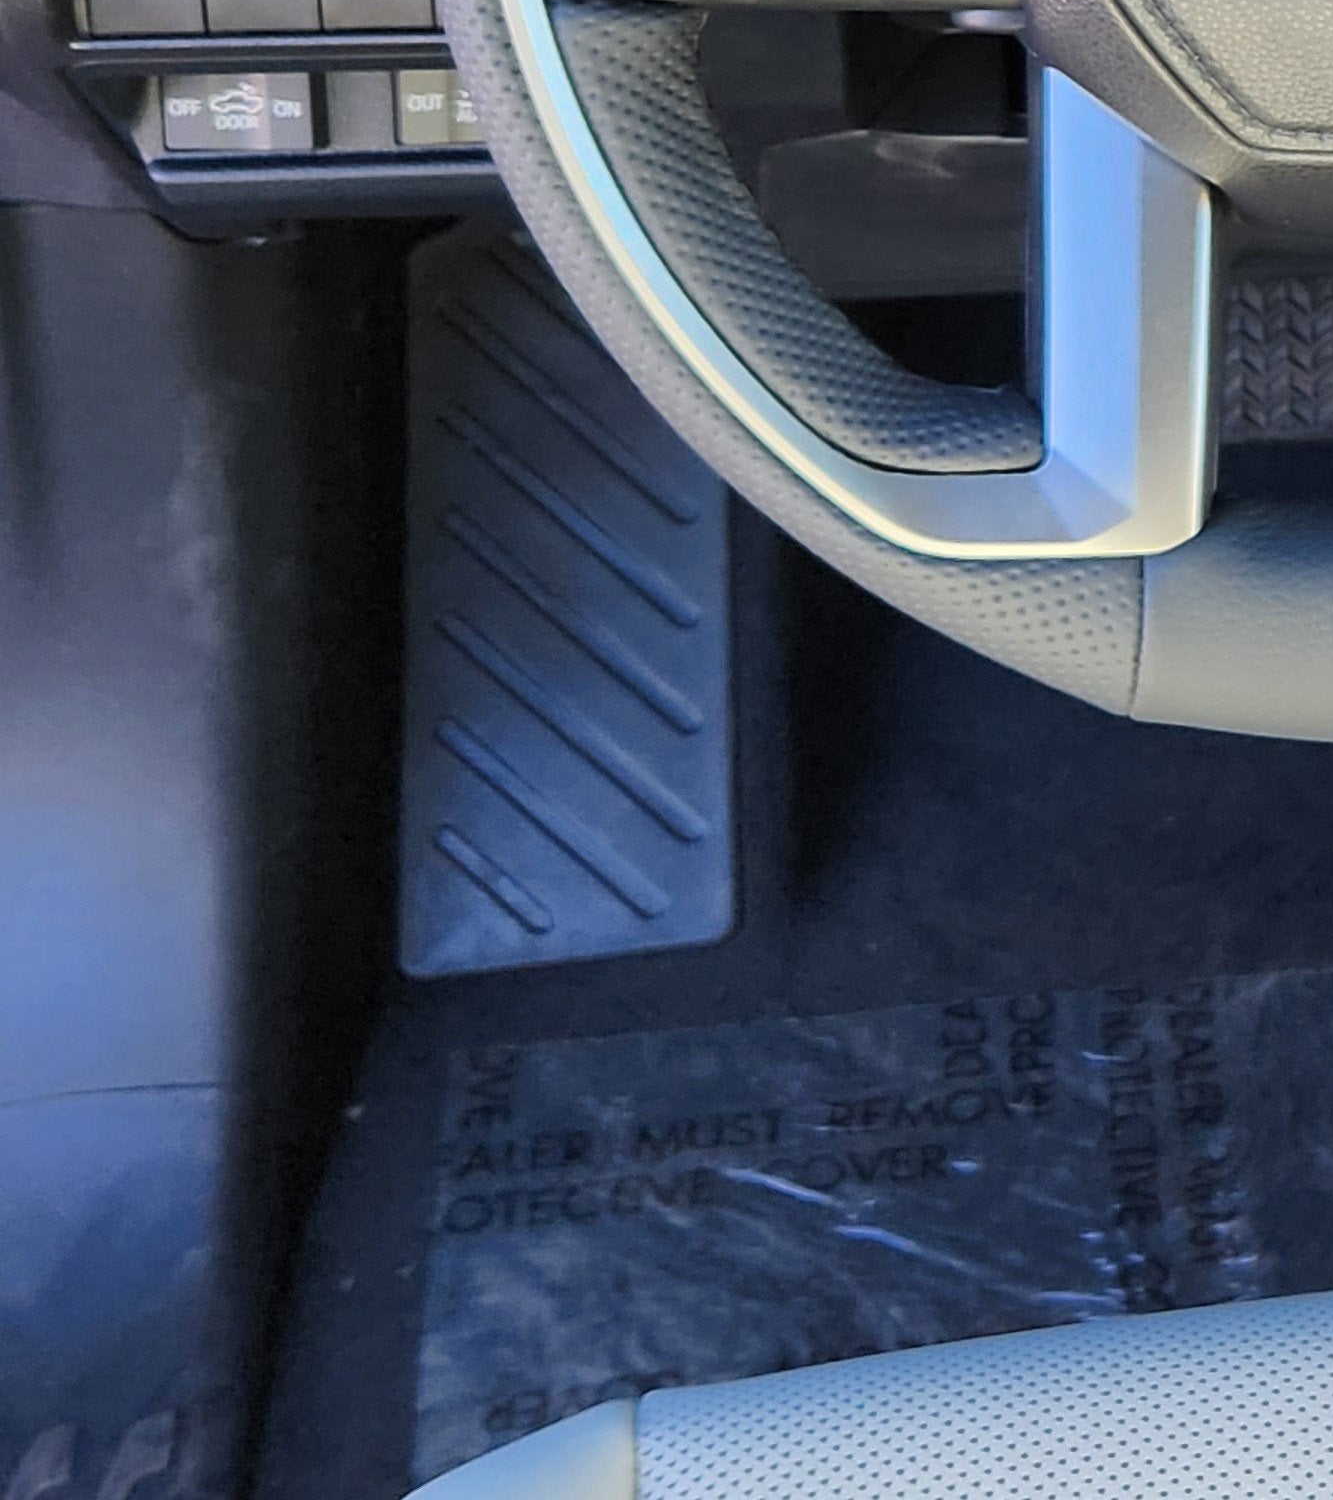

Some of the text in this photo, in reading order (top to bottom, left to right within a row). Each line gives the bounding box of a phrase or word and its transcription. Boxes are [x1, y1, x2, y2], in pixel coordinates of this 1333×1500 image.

[167, 98, 202, 117] OFF
[272, 100, 303, 118] ON
[406, 94, 444, 111] OUT
